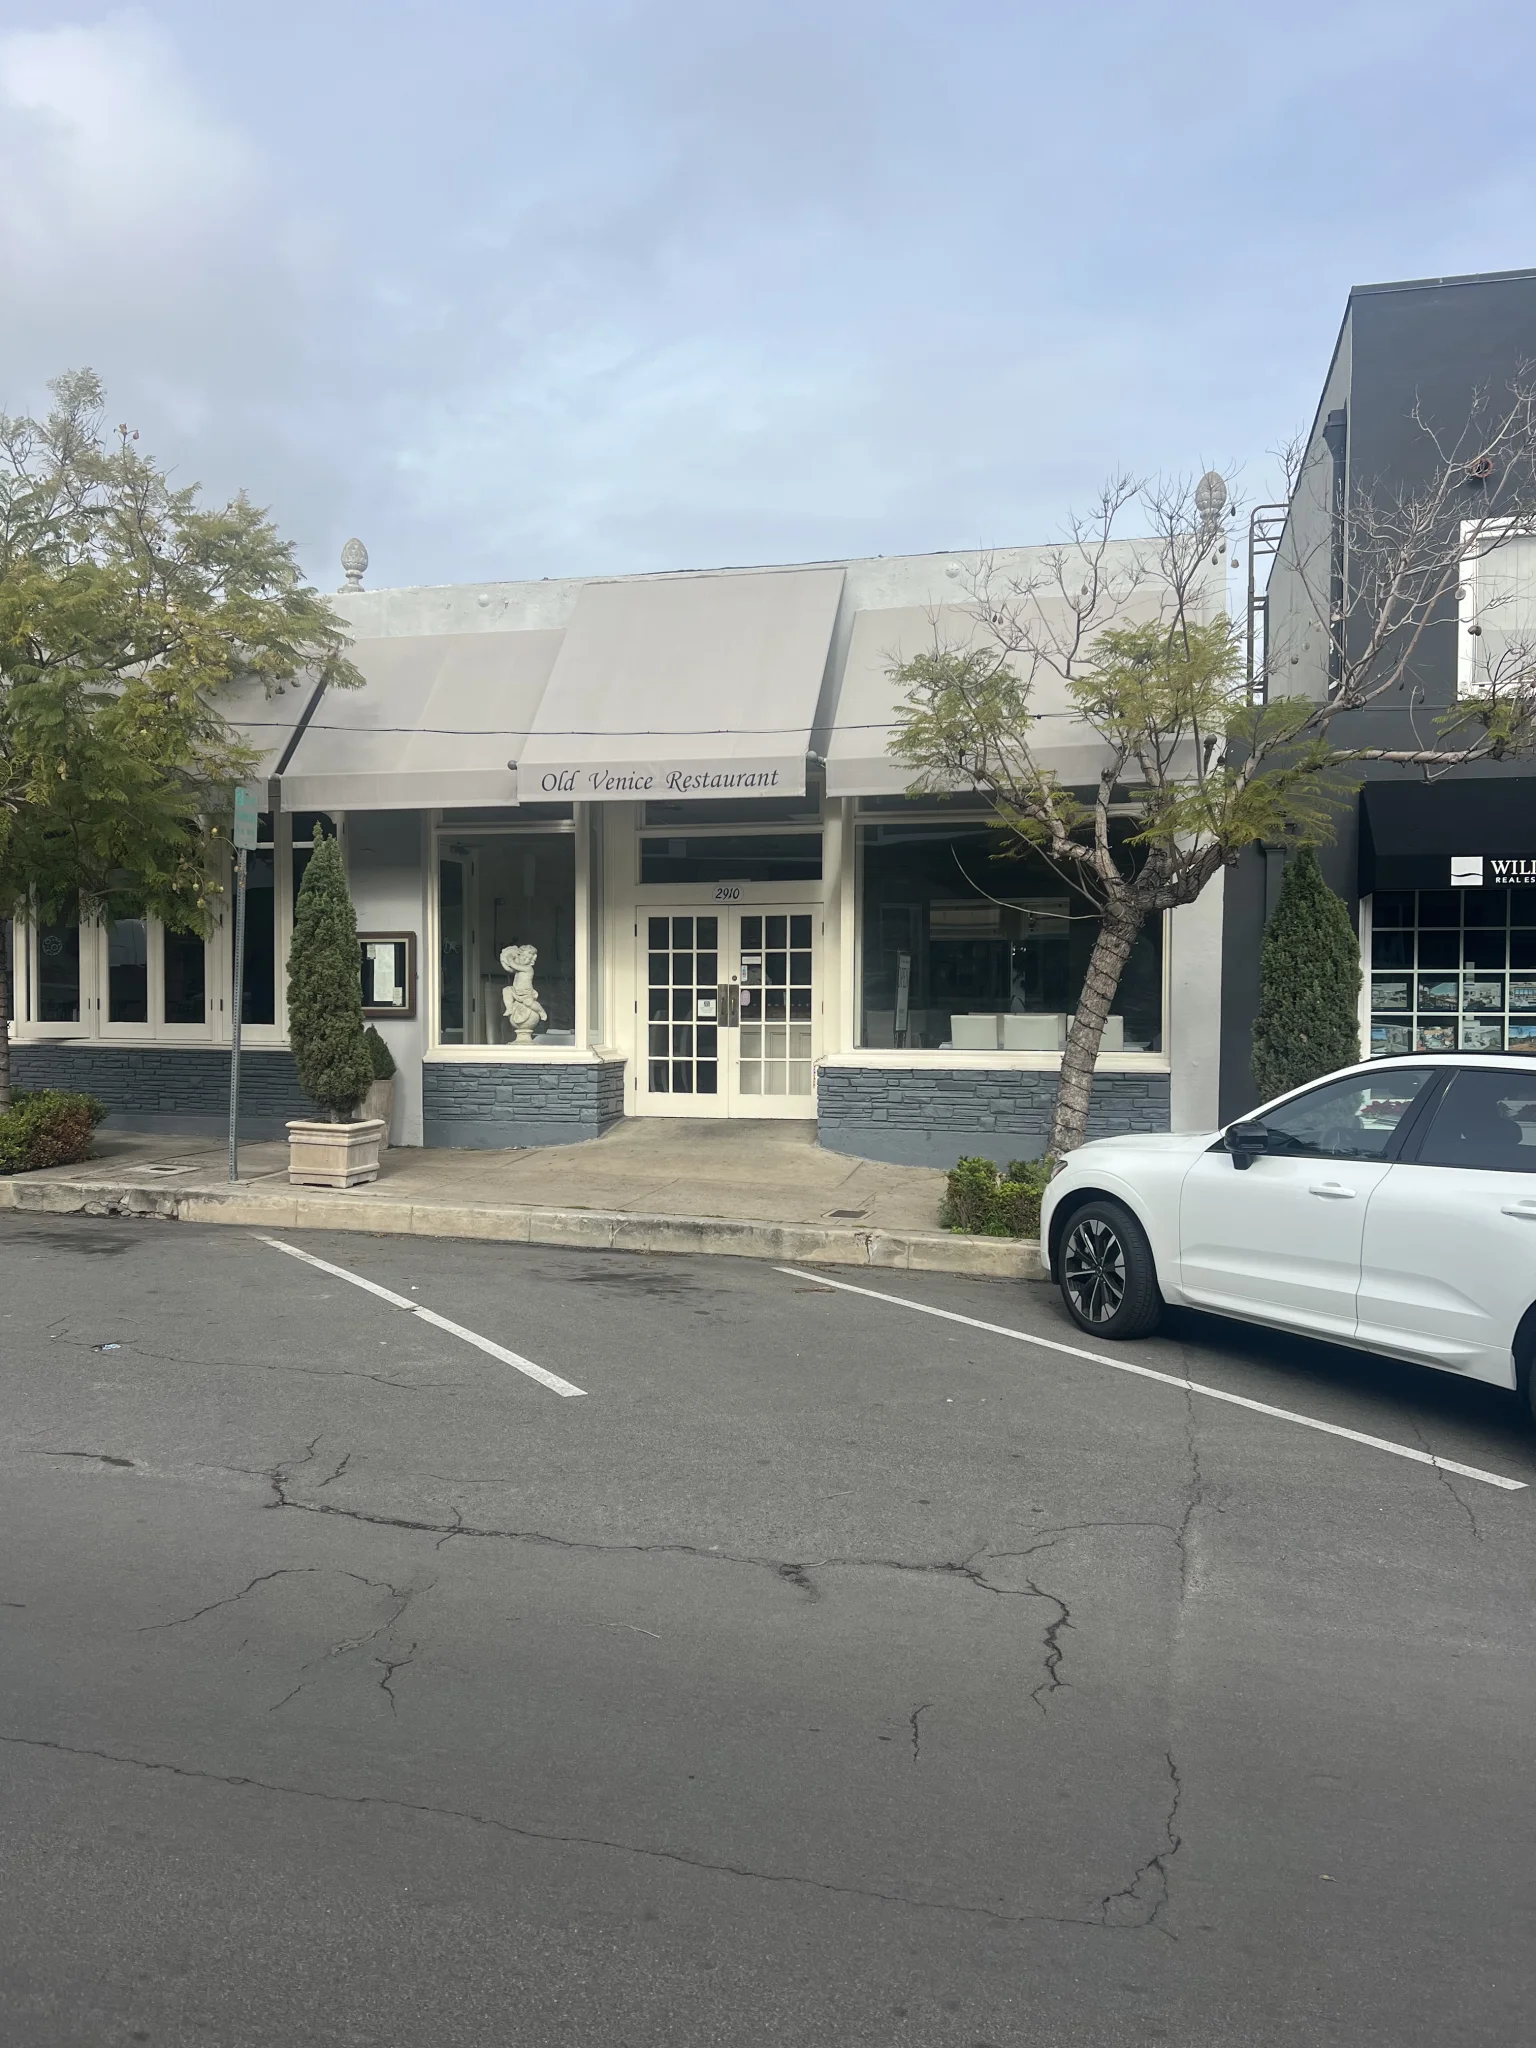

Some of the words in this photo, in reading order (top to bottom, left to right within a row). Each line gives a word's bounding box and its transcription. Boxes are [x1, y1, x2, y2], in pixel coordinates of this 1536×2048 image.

[541, 770, 581, 792] Old
[588, 769, 654, 791] Venice
[665, 769, 780, 792] Restaurant
[715, 887, 740, 900] 2910
